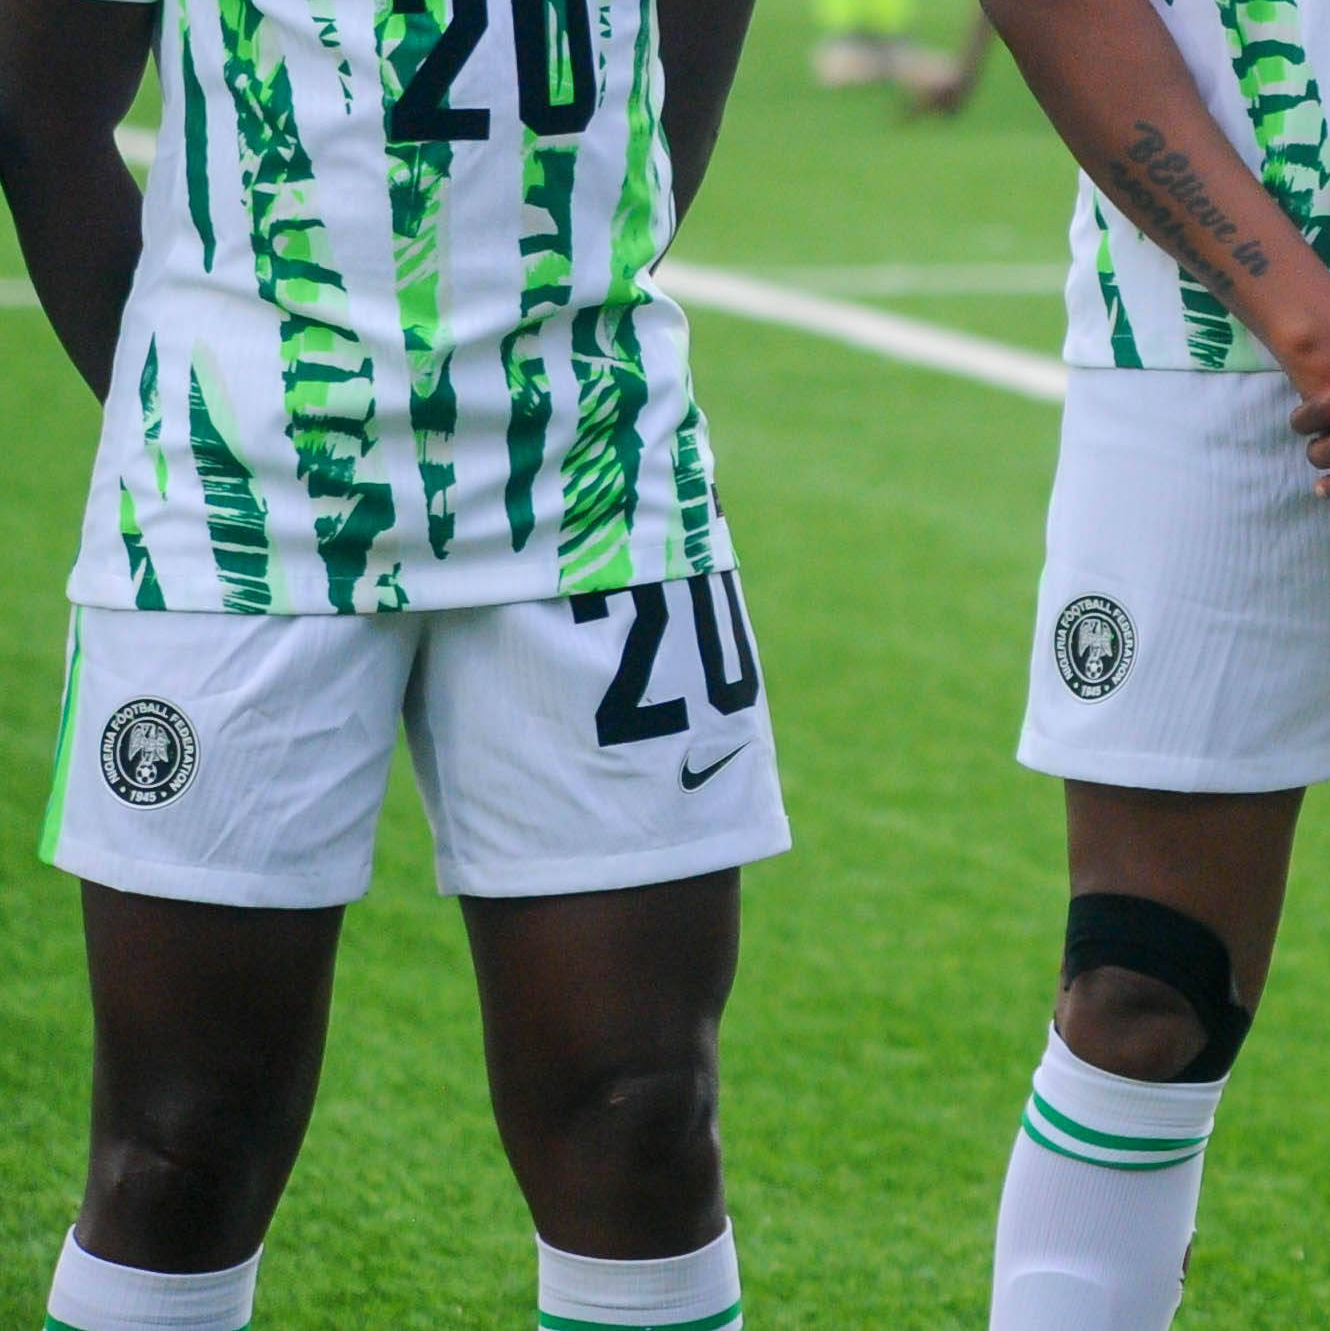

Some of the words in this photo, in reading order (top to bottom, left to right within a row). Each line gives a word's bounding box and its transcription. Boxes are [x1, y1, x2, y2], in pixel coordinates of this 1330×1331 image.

[1060, 599, 1112, 628] FOOTBALL
[569, 570, 759, 747] 20
[1057, 629, 1074, 680] NIGERIA
[1112, 608, 1133, 685] FEDERATION
[110, 702, 168, 731] FOOTBALL
[103, 732, 120, 784] NIGERIA
[169, 713, 194, 791] FEDERATION
[130, 790, 157, 802] 1945
